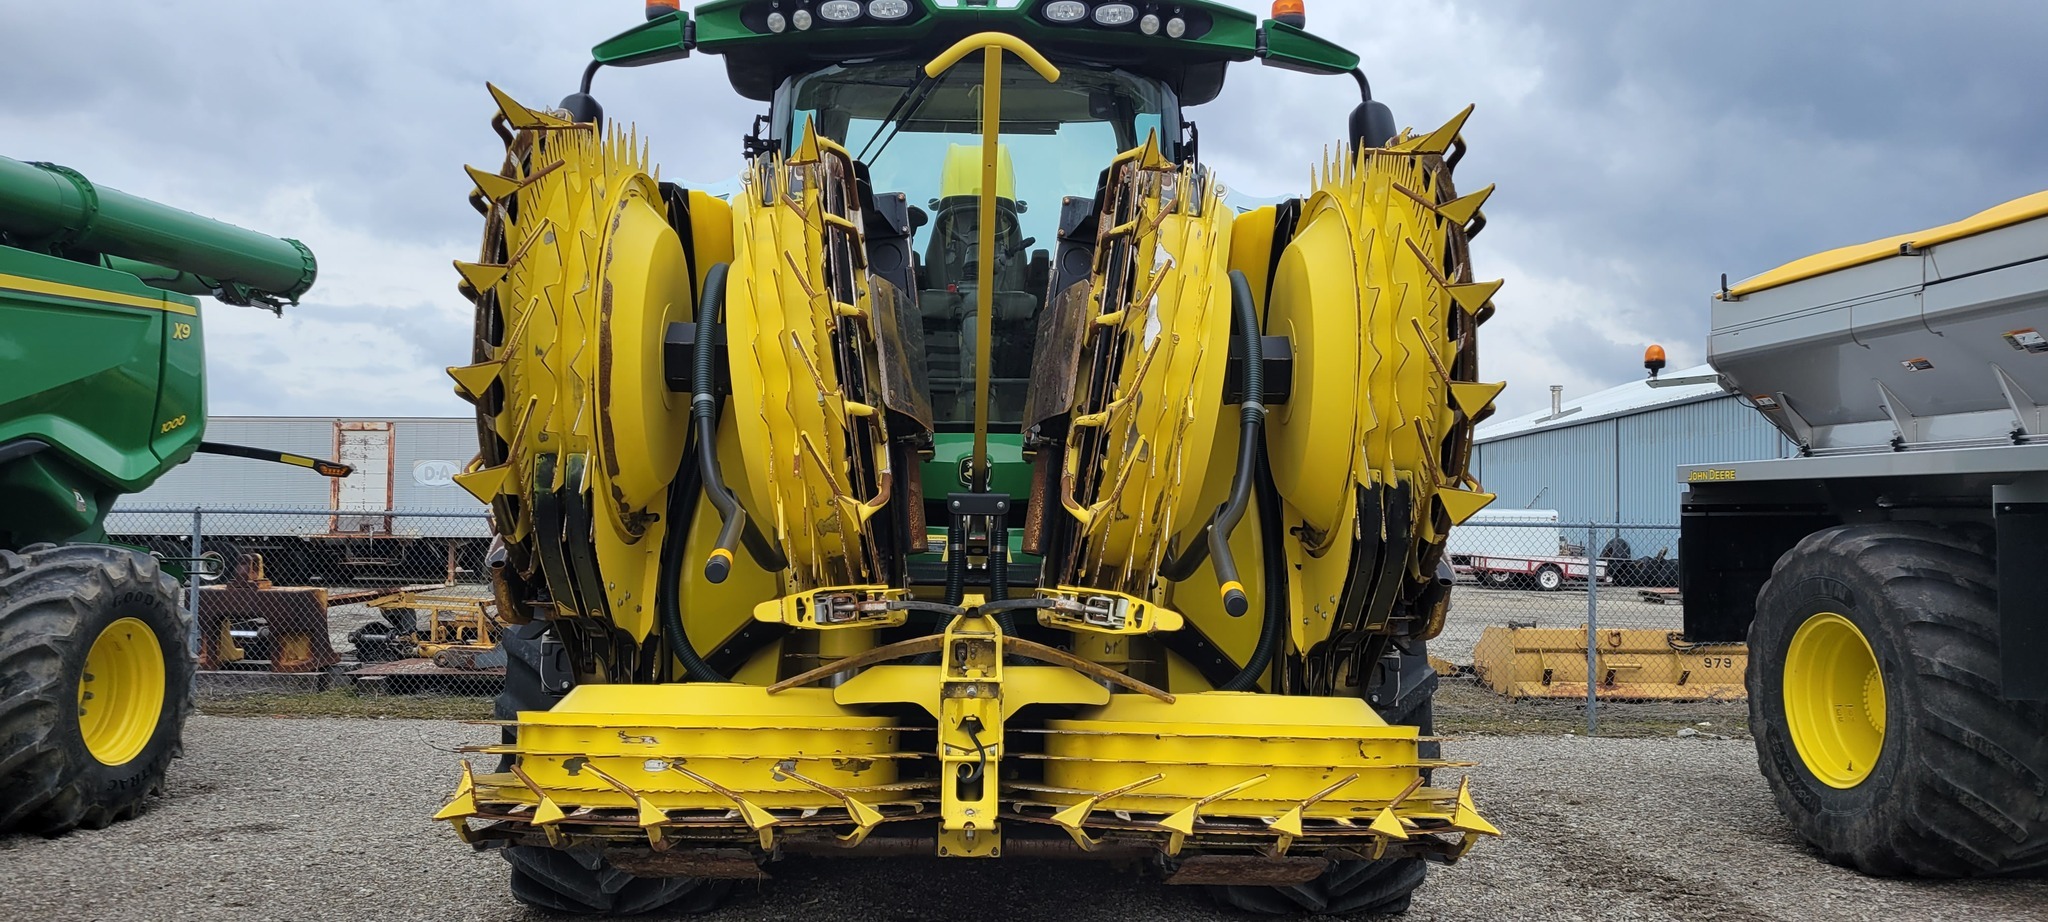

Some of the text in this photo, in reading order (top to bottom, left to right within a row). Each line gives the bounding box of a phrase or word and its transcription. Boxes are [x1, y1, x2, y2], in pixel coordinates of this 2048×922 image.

[173, 322, 191, 340] X9
[161, 414, 187, 434] 1000
[1688, 468, 1736, 481] JOHN DEERE
[1703, 657, 1732, 668] 979
